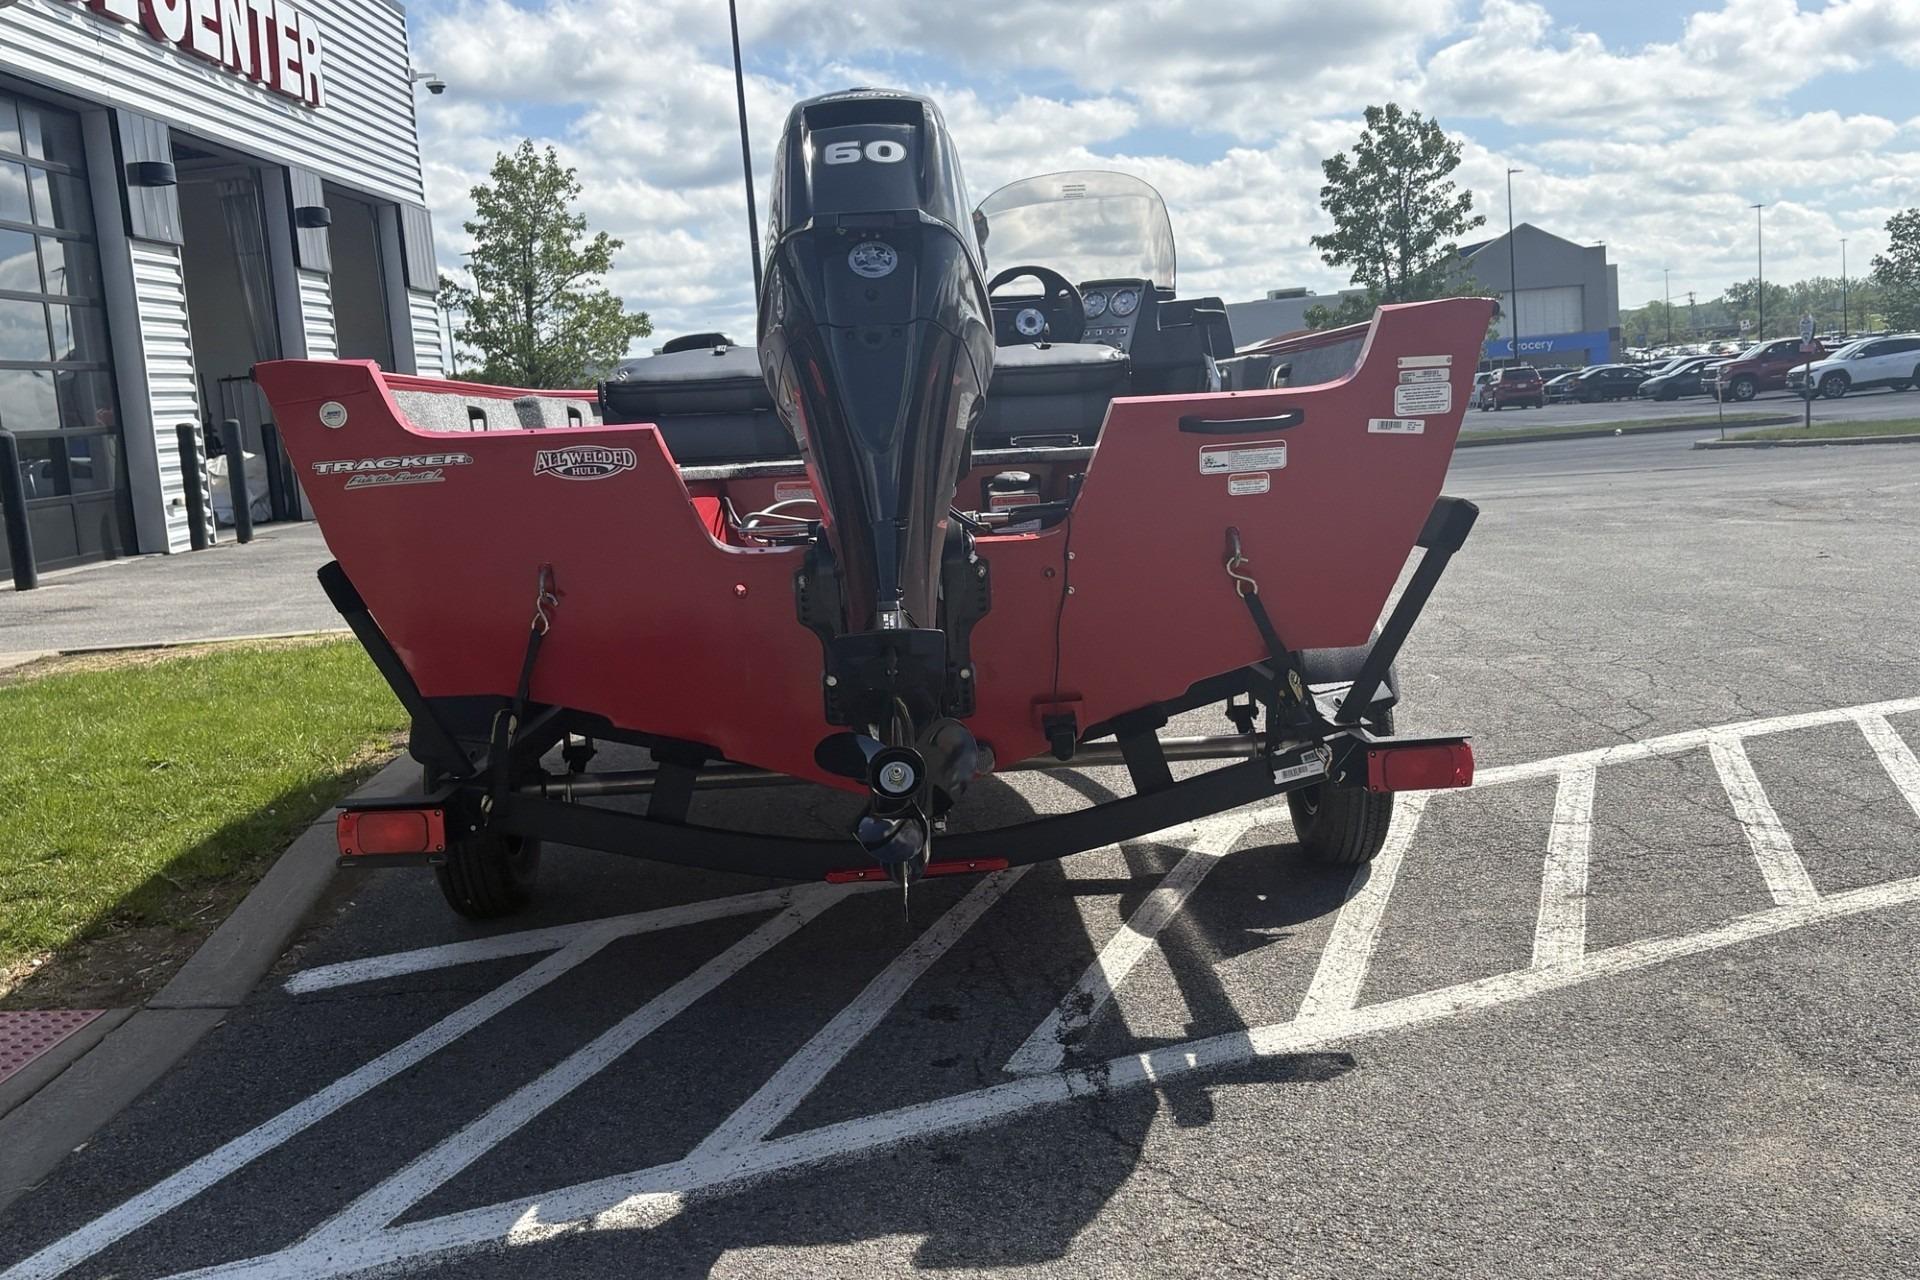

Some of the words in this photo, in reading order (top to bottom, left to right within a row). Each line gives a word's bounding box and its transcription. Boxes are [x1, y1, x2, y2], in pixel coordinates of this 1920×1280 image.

[825, 140, 906, 165] 60
[311, 453, 466, 474] TRACKER
[536, 452, 566, 471] ALL
[566, 450, 634, 467] WELDED
[572, 466, 601, 476] HULL
